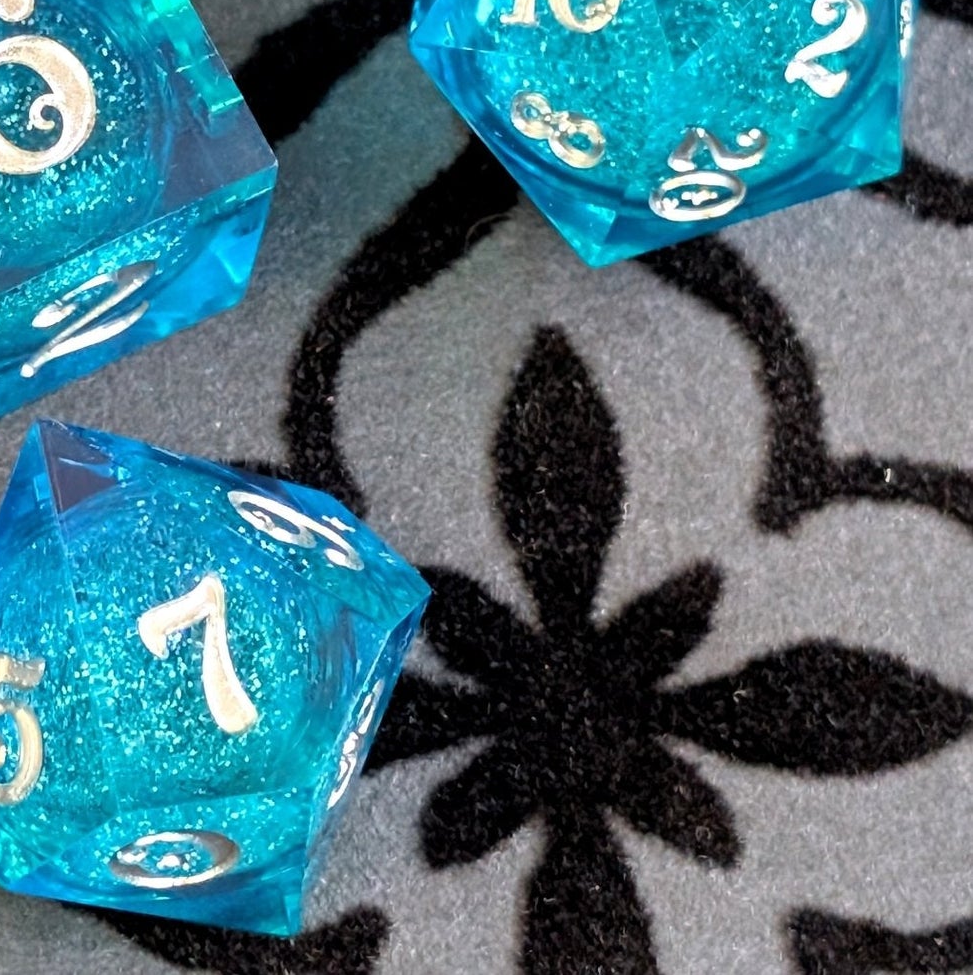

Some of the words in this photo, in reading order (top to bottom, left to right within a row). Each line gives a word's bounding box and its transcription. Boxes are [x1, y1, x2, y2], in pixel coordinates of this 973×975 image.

[509, 91, 607, 169] 8
[648, 126, 770, 223] 20
[19, 260, 158, 379] 2
[137, 571, 259, 735] 7
[109, 830, 240, 889] 0
